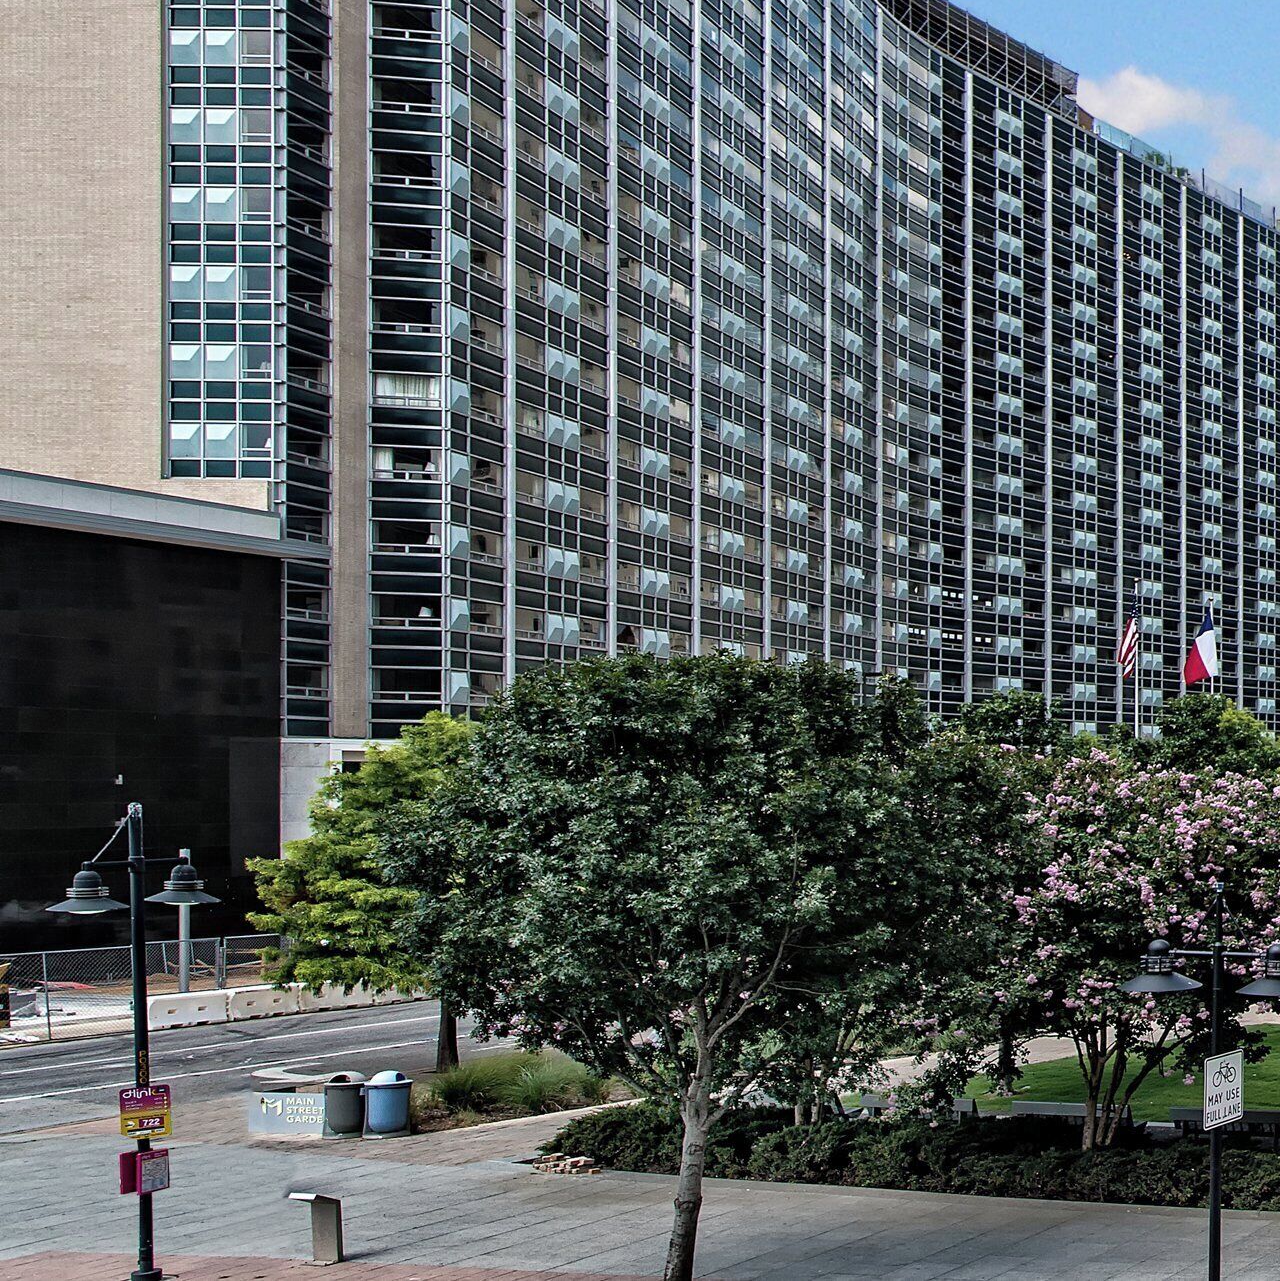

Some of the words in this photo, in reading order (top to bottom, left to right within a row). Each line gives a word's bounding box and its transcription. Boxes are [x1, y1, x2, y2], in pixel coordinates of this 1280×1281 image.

[286, 1097, 314, 1105] MAIN
[1208, 1092, 1223, 1107] MAY
[1226, 1087, 1240, 1101] USE
[286, 1106, 325, 1114] STREET
[1206, 1109, 1221, 1124] FULL
[1222, 1102, 1241, 1119] LANE
[142, 1118, 160, 1127] 722
[286, 1115, 324, 1124] GARDE
